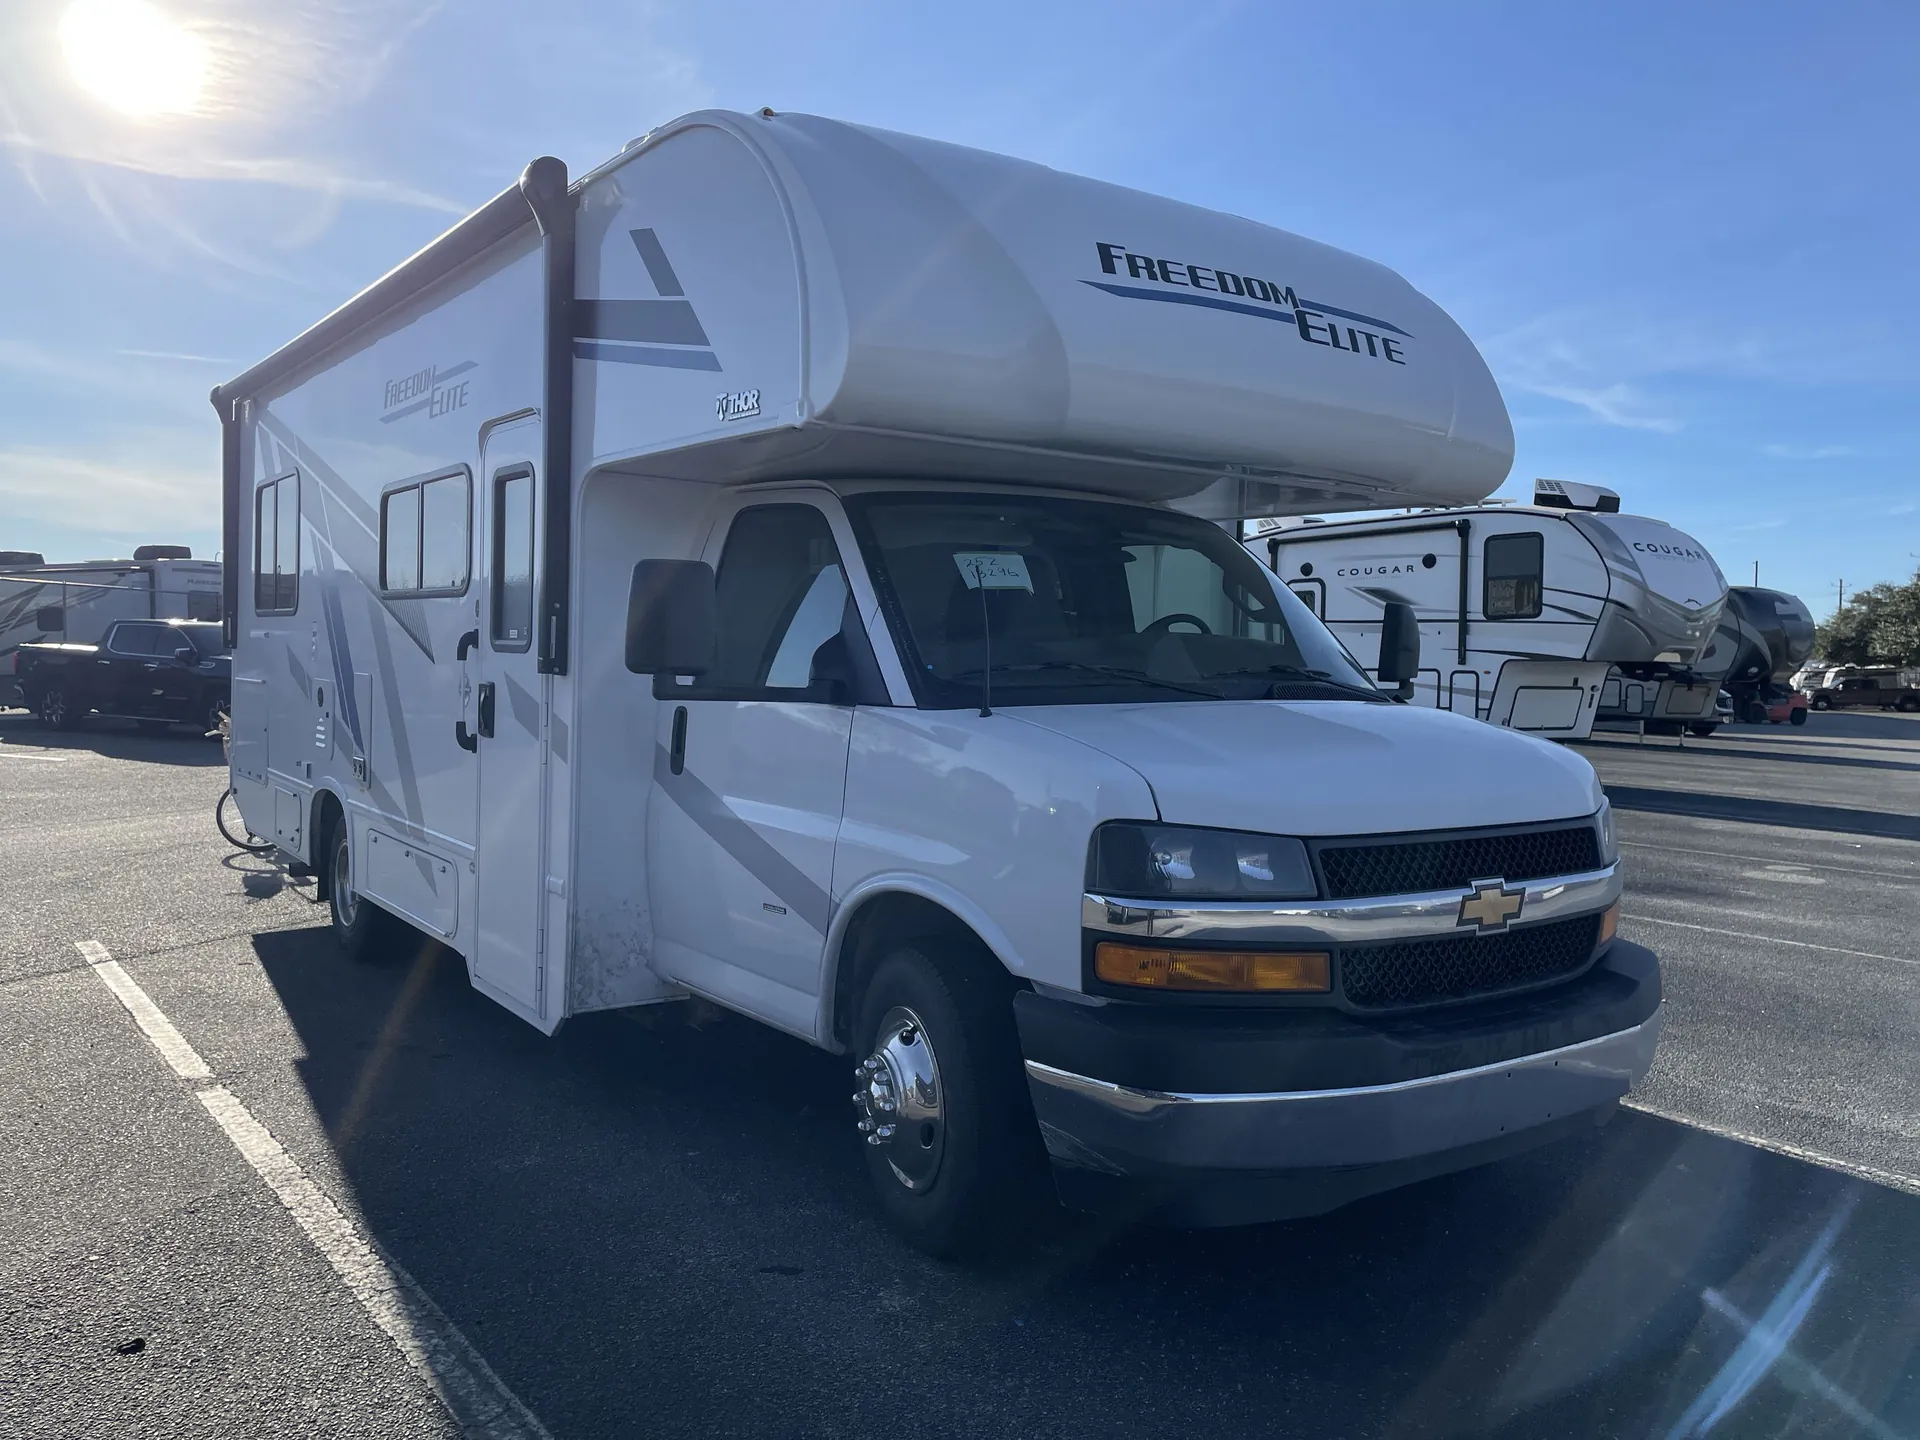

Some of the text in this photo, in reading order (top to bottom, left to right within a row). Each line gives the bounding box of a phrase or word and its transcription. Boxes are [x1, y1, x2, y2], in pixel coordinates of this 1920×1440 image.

[1095, 241, 1300, 310] FREEDOM
[1294, 309, 1407, 366] ELITE
[384, 364, 437, 410] FREEDOM
[428, 380, 470, 419] ELITE
[728, 388, 761, 415] THOR
[1337, 564, 1415, 577] COUGAR
[1633, 542, 1705, 561] COUGAR
